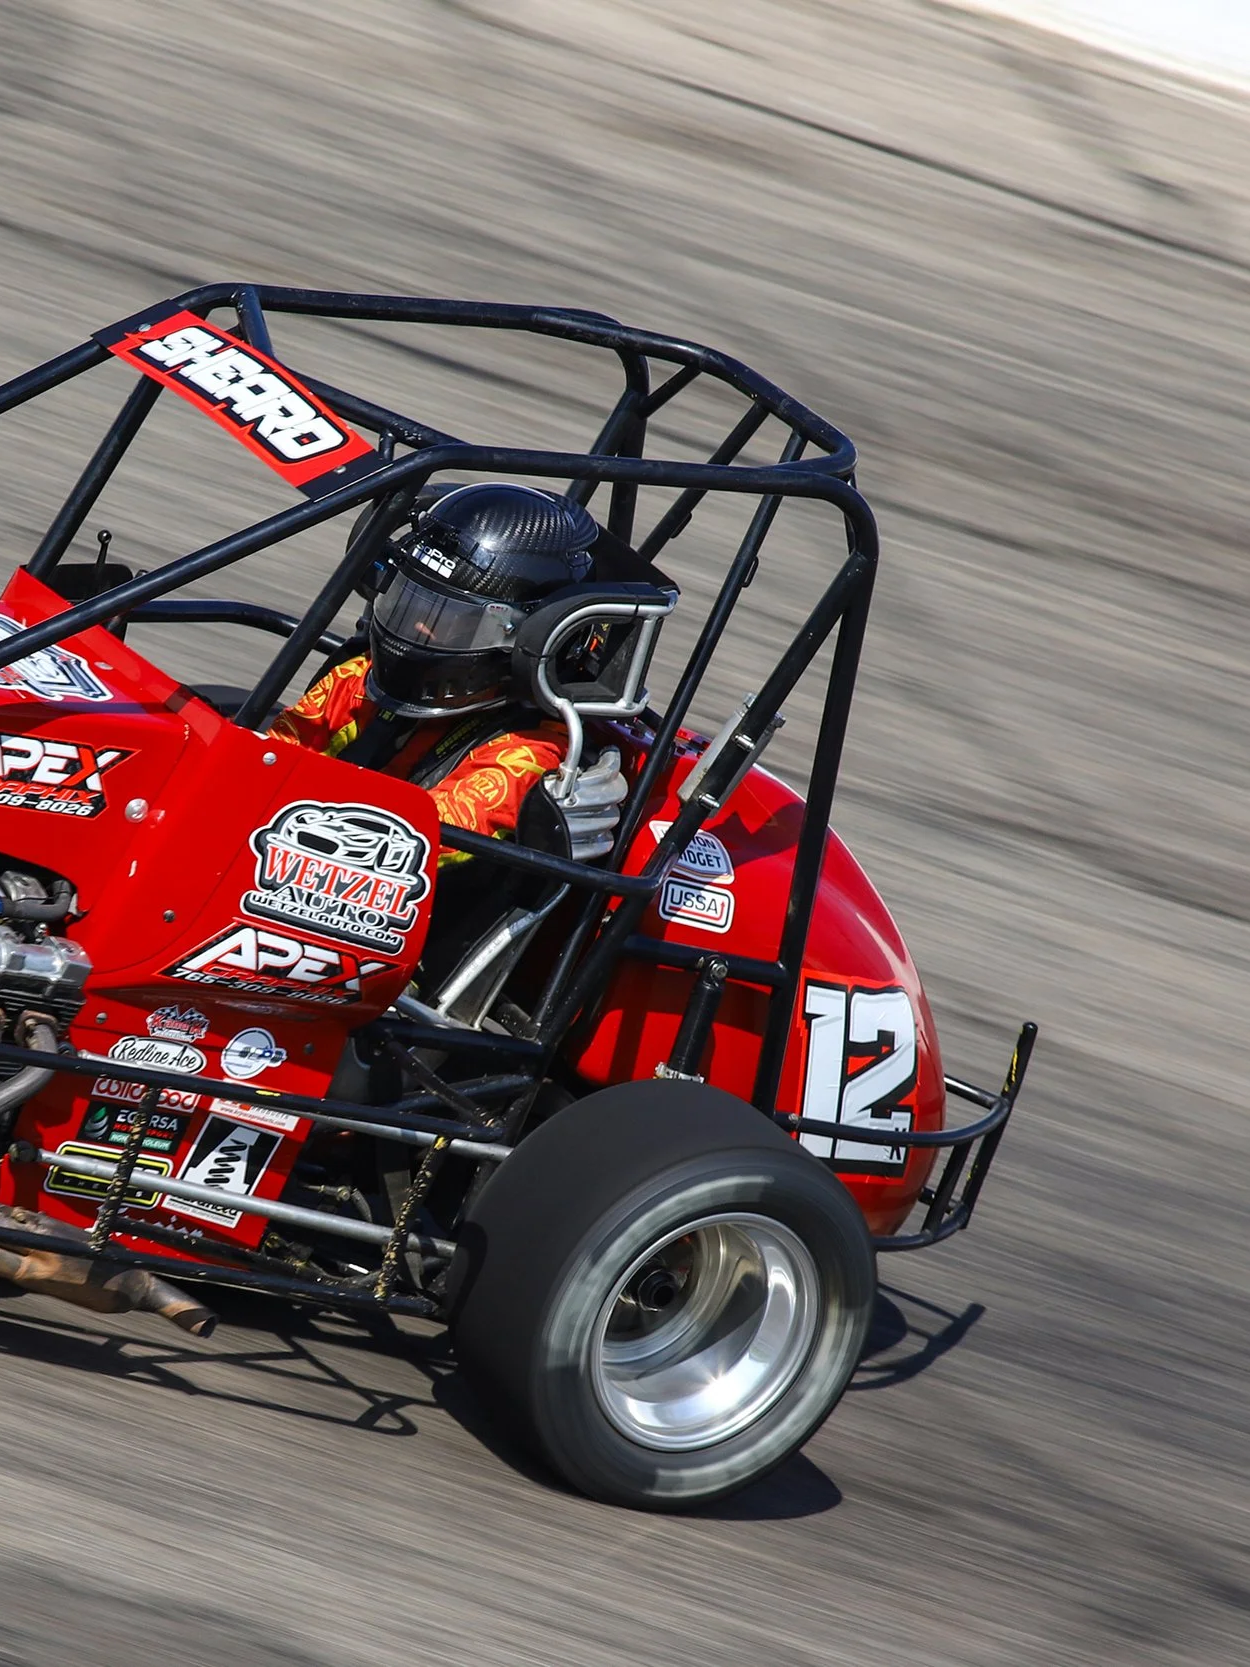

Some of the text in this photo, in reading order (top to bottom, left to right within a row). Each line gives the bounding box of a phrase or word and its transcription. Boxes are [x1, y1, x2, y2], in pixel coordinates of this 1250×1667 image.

[139, 326, 346, 460] SHEARD
[416, 540, 456, 570] GoPro
[465, 773, 500, 802] PIZZA
[680, 849, 721, 868] IDGET
[263, 845, 413, 919] WETZEL
[250, 893, 400, 944] WETZELAUTO.COM
[271, 885, 387, 929] AUTO
[670, 887, 719, 915] USSA
[182, 927, 387, 992] APEX
[202, 963, 357, 998] GRAPHIX
[117, 1038, 197, 1069] Redline Ace
[799, 984, 916, 1164] 12
[116, 1108, 178, 1131] ECRSA
